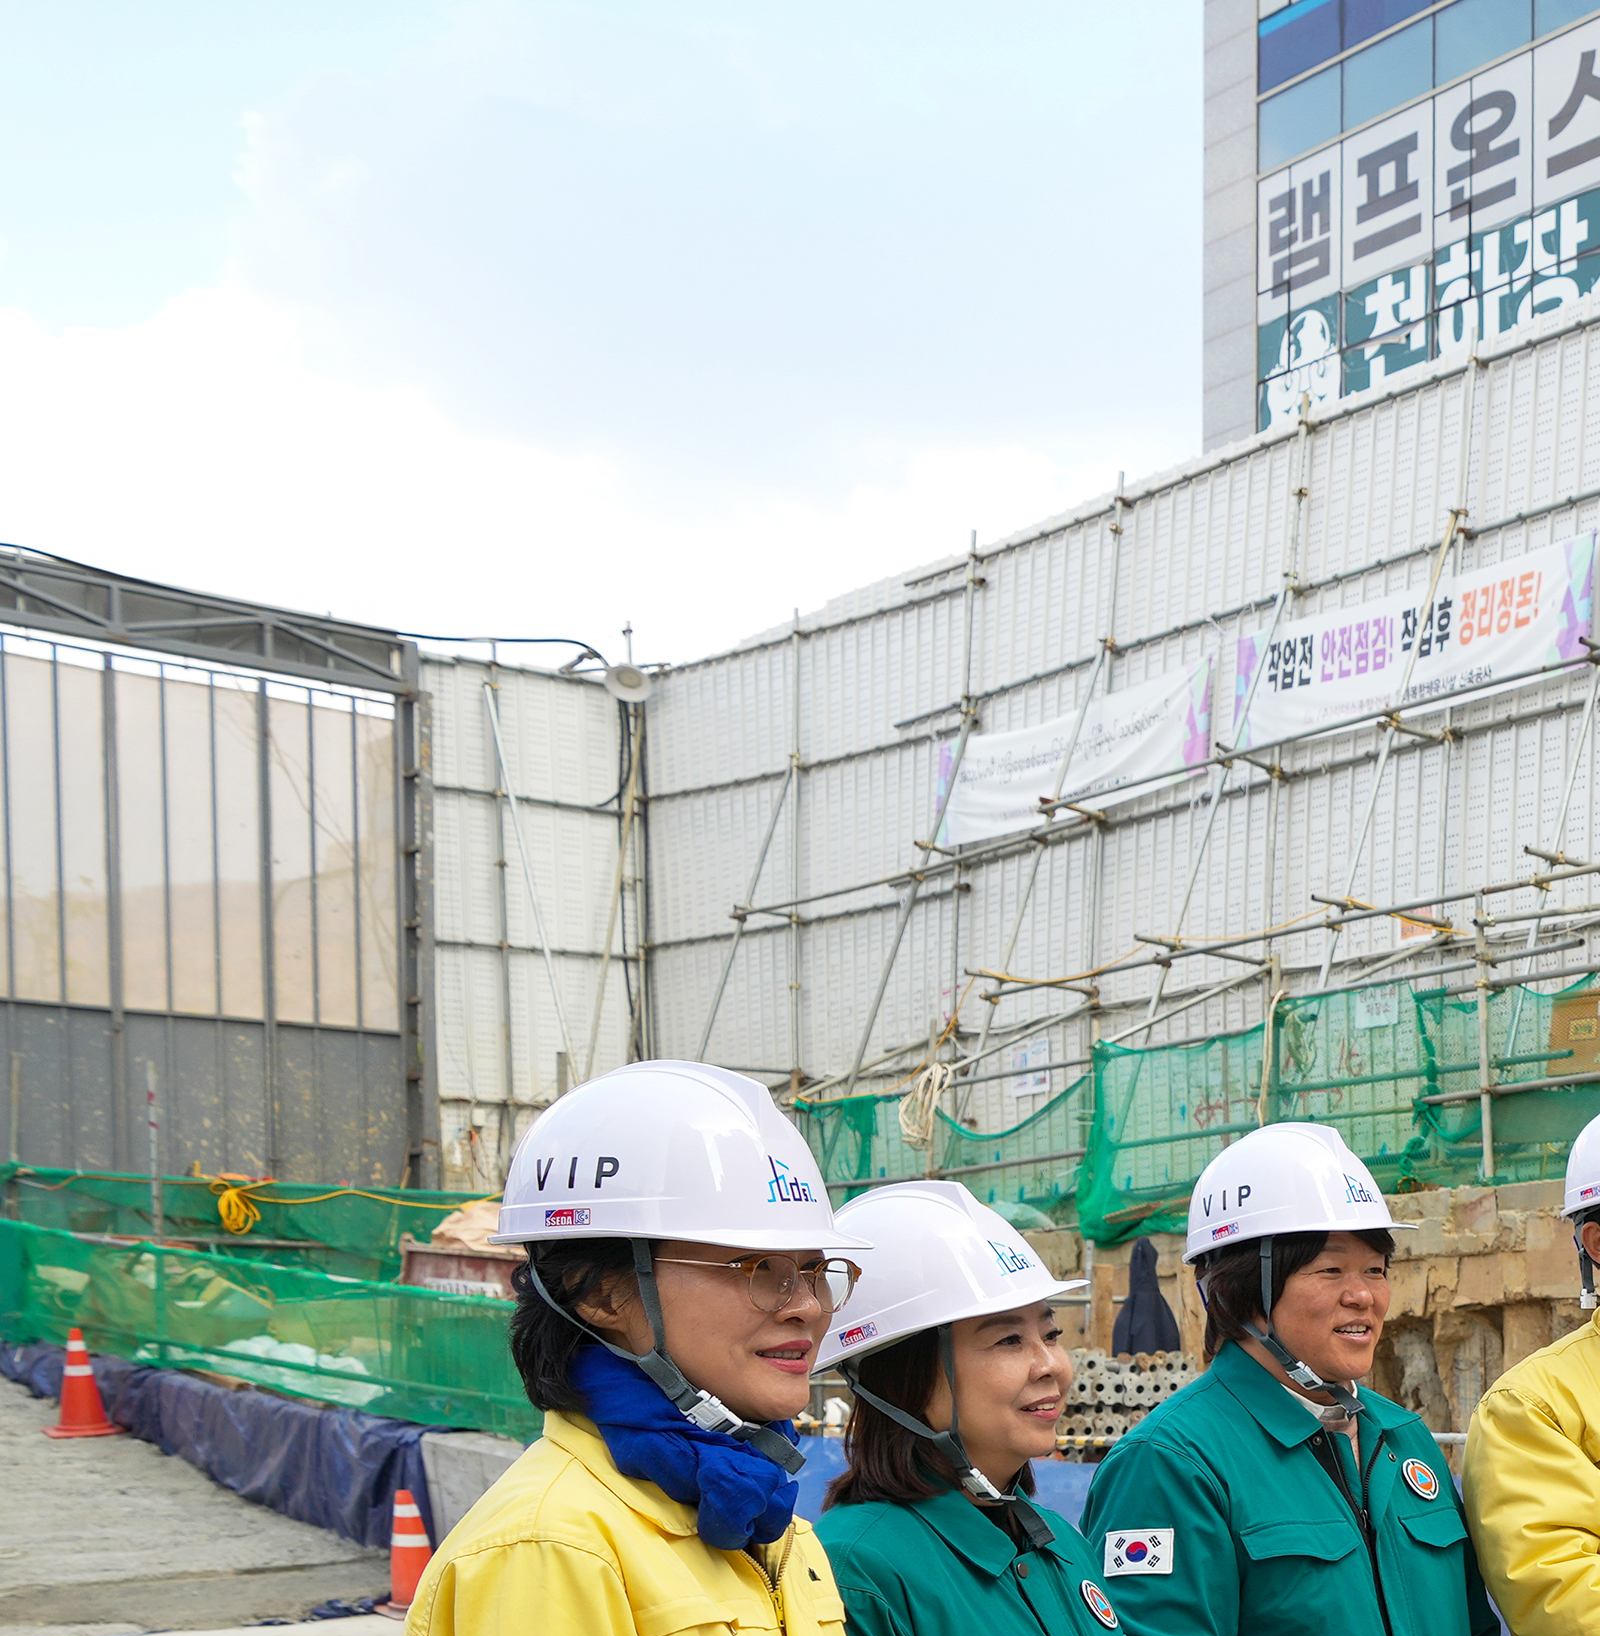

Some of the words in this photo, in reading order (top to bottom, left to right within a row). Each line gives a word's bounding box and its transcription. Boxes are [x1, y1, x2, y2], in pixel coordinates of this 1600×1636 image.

[1267, 634, 1314, 693] 작업전
[1320, 616, 1394, 683] 안전점검!
[1459, 571, 1542, 647] 정리정돈!
[536, 1156, 620, 1191] VIP
[1203, 1185, 1252, 1218] VIP
